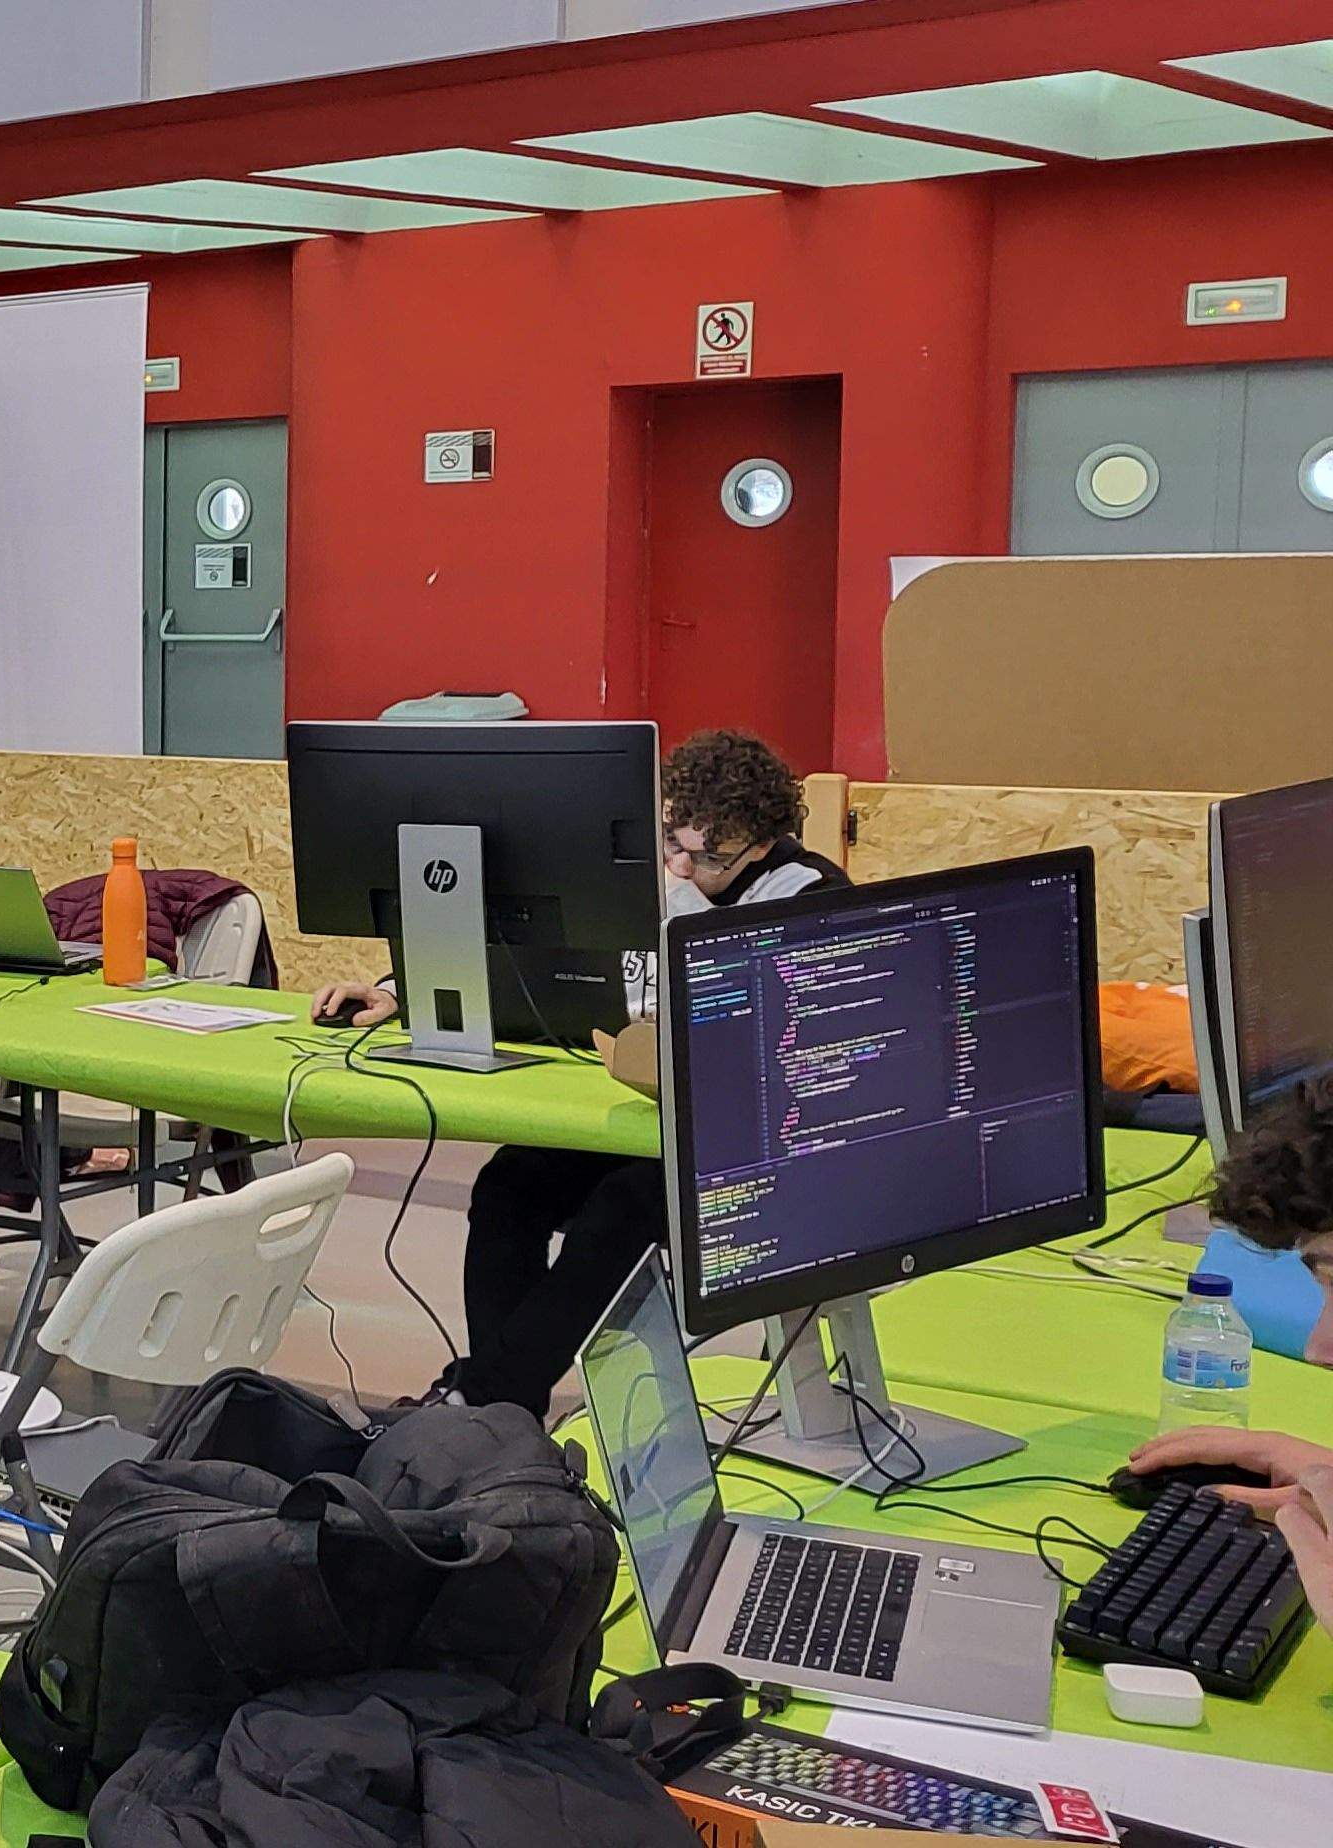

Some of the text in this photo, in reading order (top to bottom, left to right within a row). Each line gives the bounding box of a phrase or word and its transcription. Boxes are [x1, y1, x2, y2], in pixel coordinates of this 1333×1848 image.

[425, 857, 455, 894] hp
[724, 1784, 877, 1829] KASIC TK
